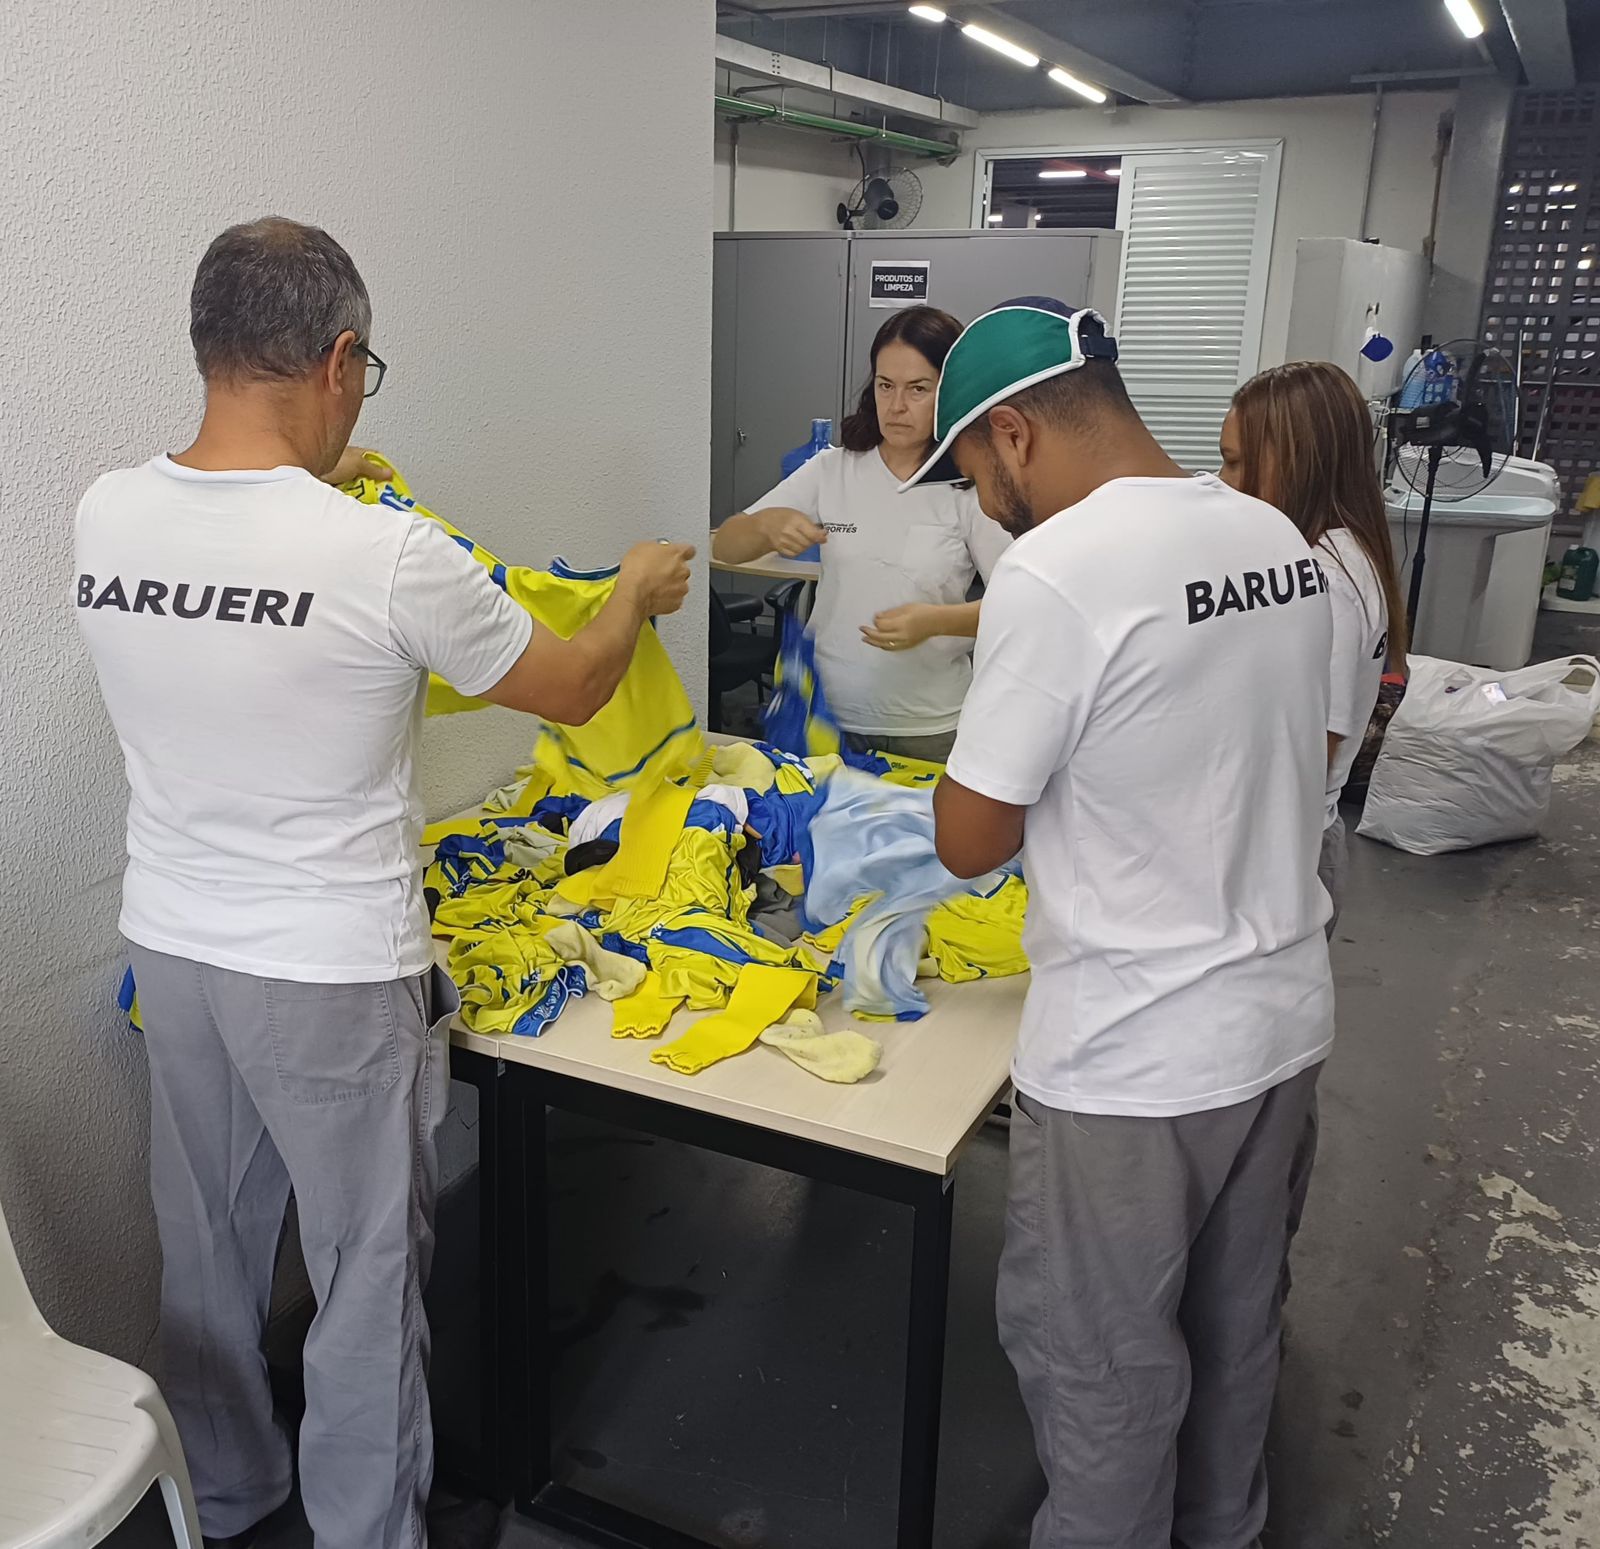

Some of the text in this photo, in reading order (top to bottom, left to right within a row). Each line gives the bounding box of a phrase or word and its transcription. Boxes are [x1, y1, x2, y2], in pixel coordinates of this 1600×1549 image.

[875, 274, 913, 282] PRODUTOS
[884, 283, 914, 291] LIMPEZA
[77, 574, 315, 627] BARUERI
[1185, 558, 1329, 625] BARUER
